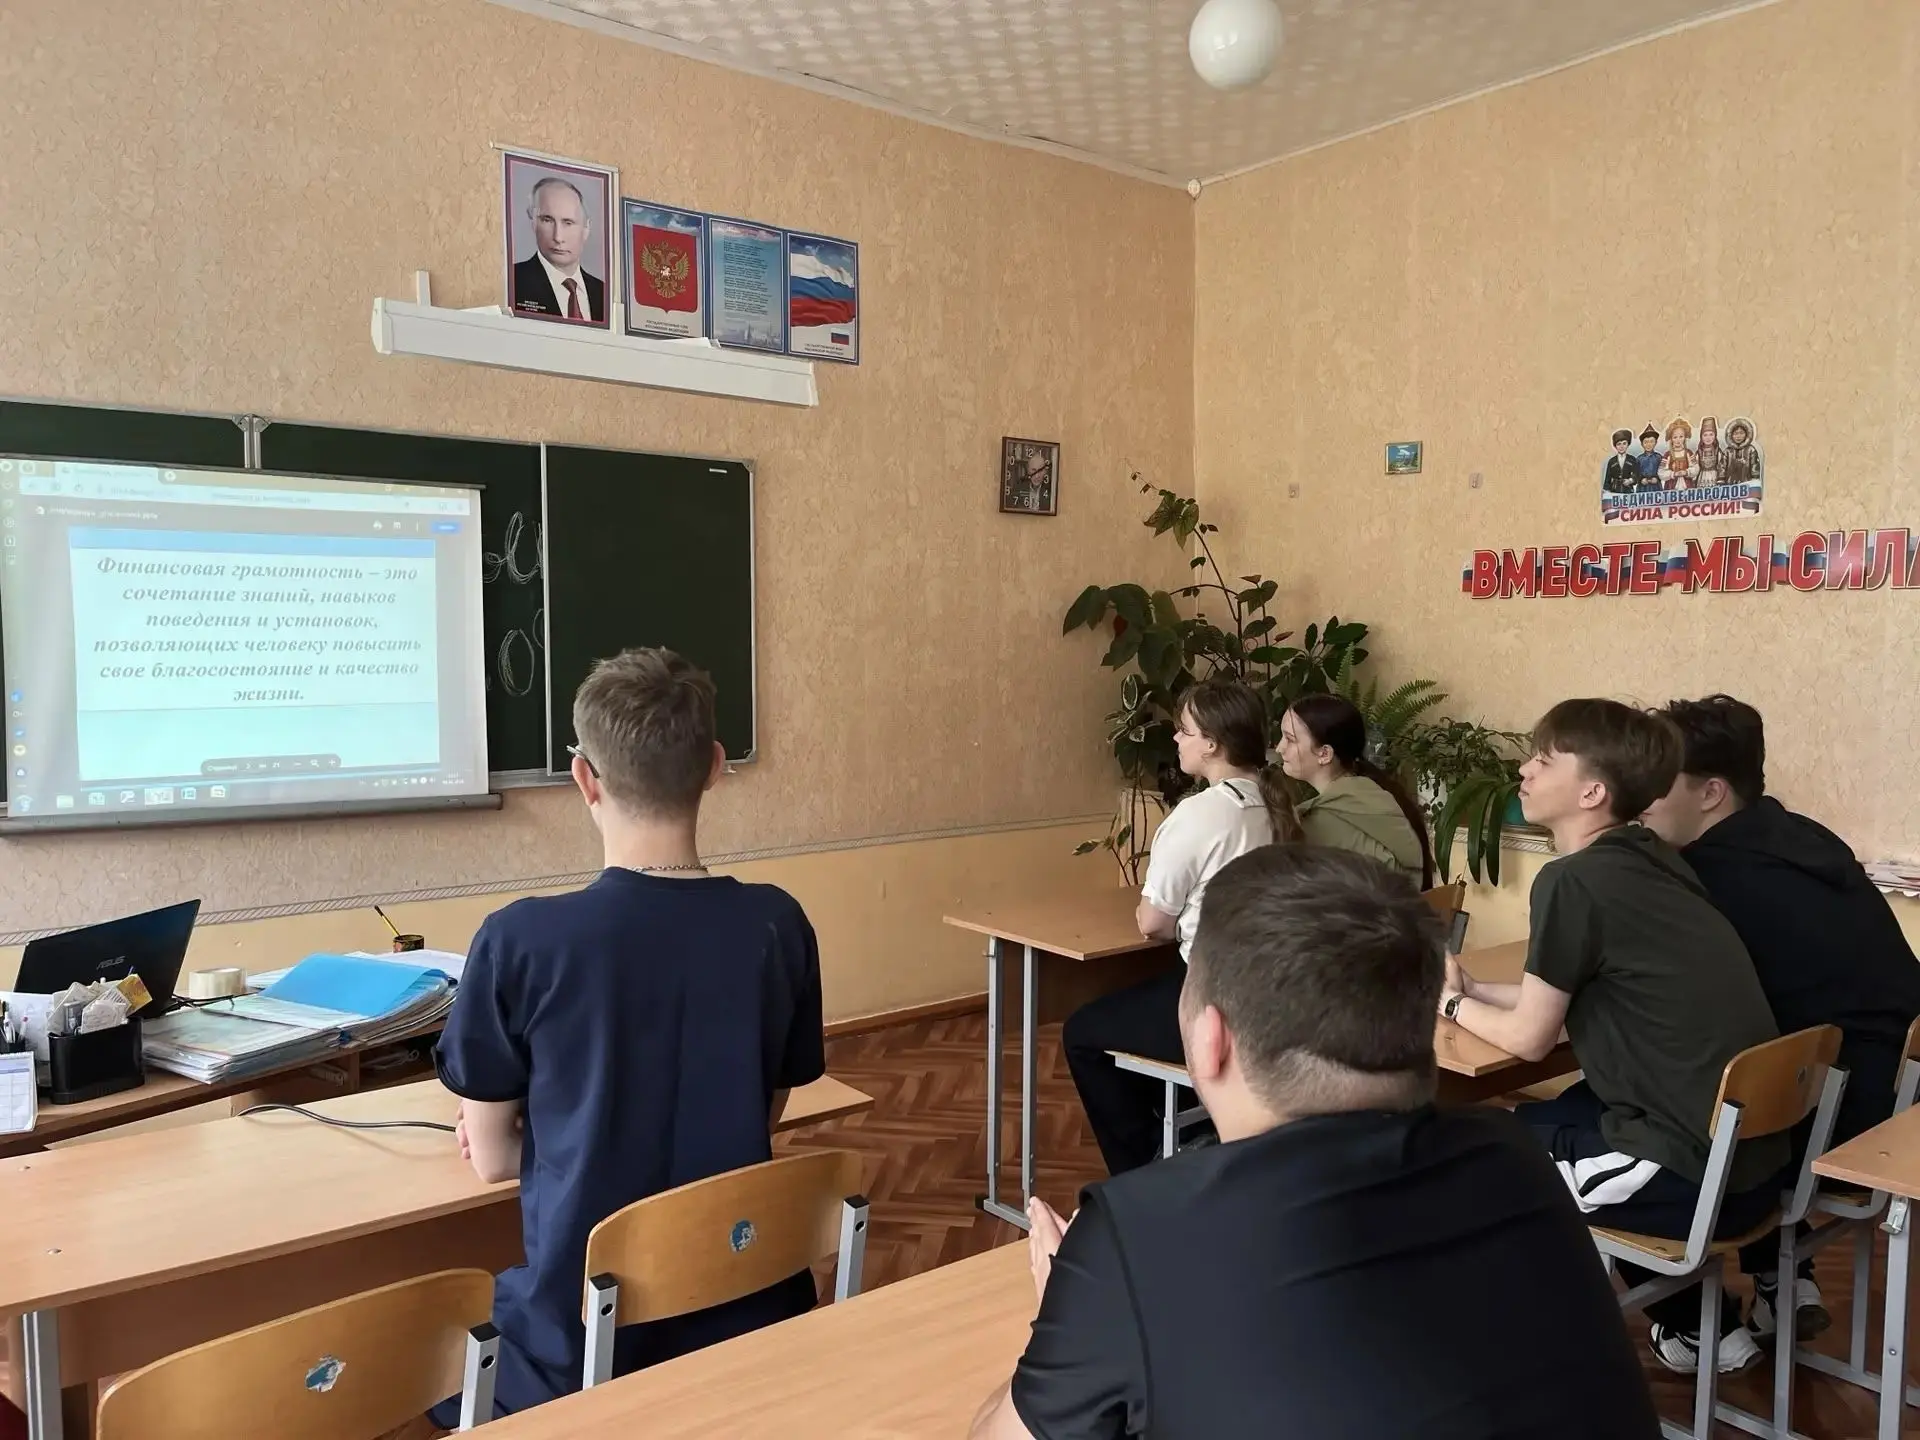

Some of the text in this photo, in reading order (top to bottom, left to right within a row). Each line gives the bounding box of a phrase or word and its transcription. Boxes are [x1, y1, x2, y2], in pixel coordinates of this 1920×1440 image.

[1611, 484, 1749, 508] В ЕДИНСТВЕ НАРОДОВ
[1620, 502, 1741, 522] СИЛА РОССИИ!
[97, 556, 226, 576] Финансовая
[231, 564, 363, 581] грамотность
[384, 568, 418, 580] это
[1471, 540, 1662, 600] ВМЕСТЕ
[1680, 533, 1775, 595] МЫ
[122, 587, 397, 605] сочетание знаний, навыков
[146, 611, 379, 631] поведения и установок,
[94, 639, 422, 655] позволяющих человеку повысить
[100, 662, 419, 678] свое благосостояние и качество
[233, 688, 304, 702] жизни.
